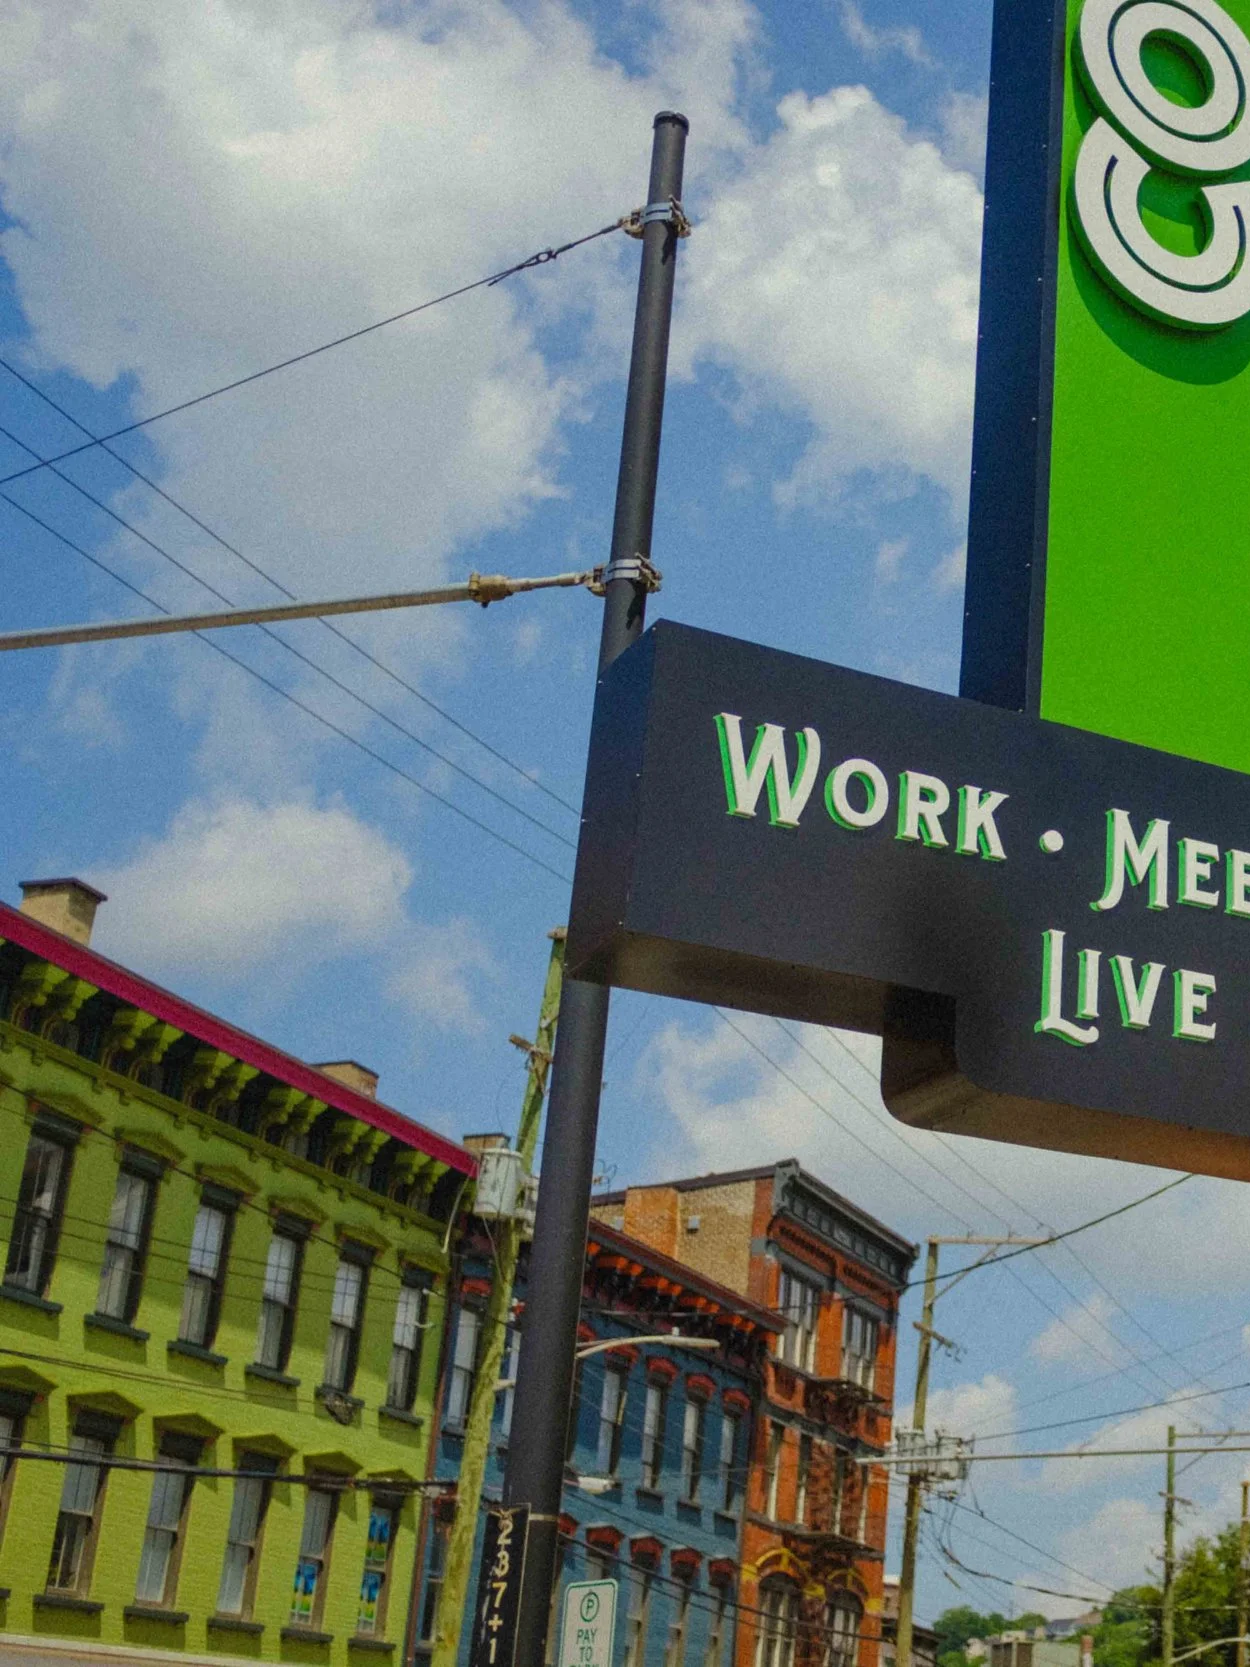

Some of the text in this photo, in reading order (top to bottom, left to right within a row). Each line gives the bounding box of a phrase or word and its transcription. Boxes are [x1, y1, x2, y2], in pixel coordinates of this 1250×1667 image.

[712, 711, 1009, 862] WORK
[1034, 929, 1217, 1047] LIVE
[576, 1628, 598, 1645] PAY
[579, 1646, 593, 1662] TO
